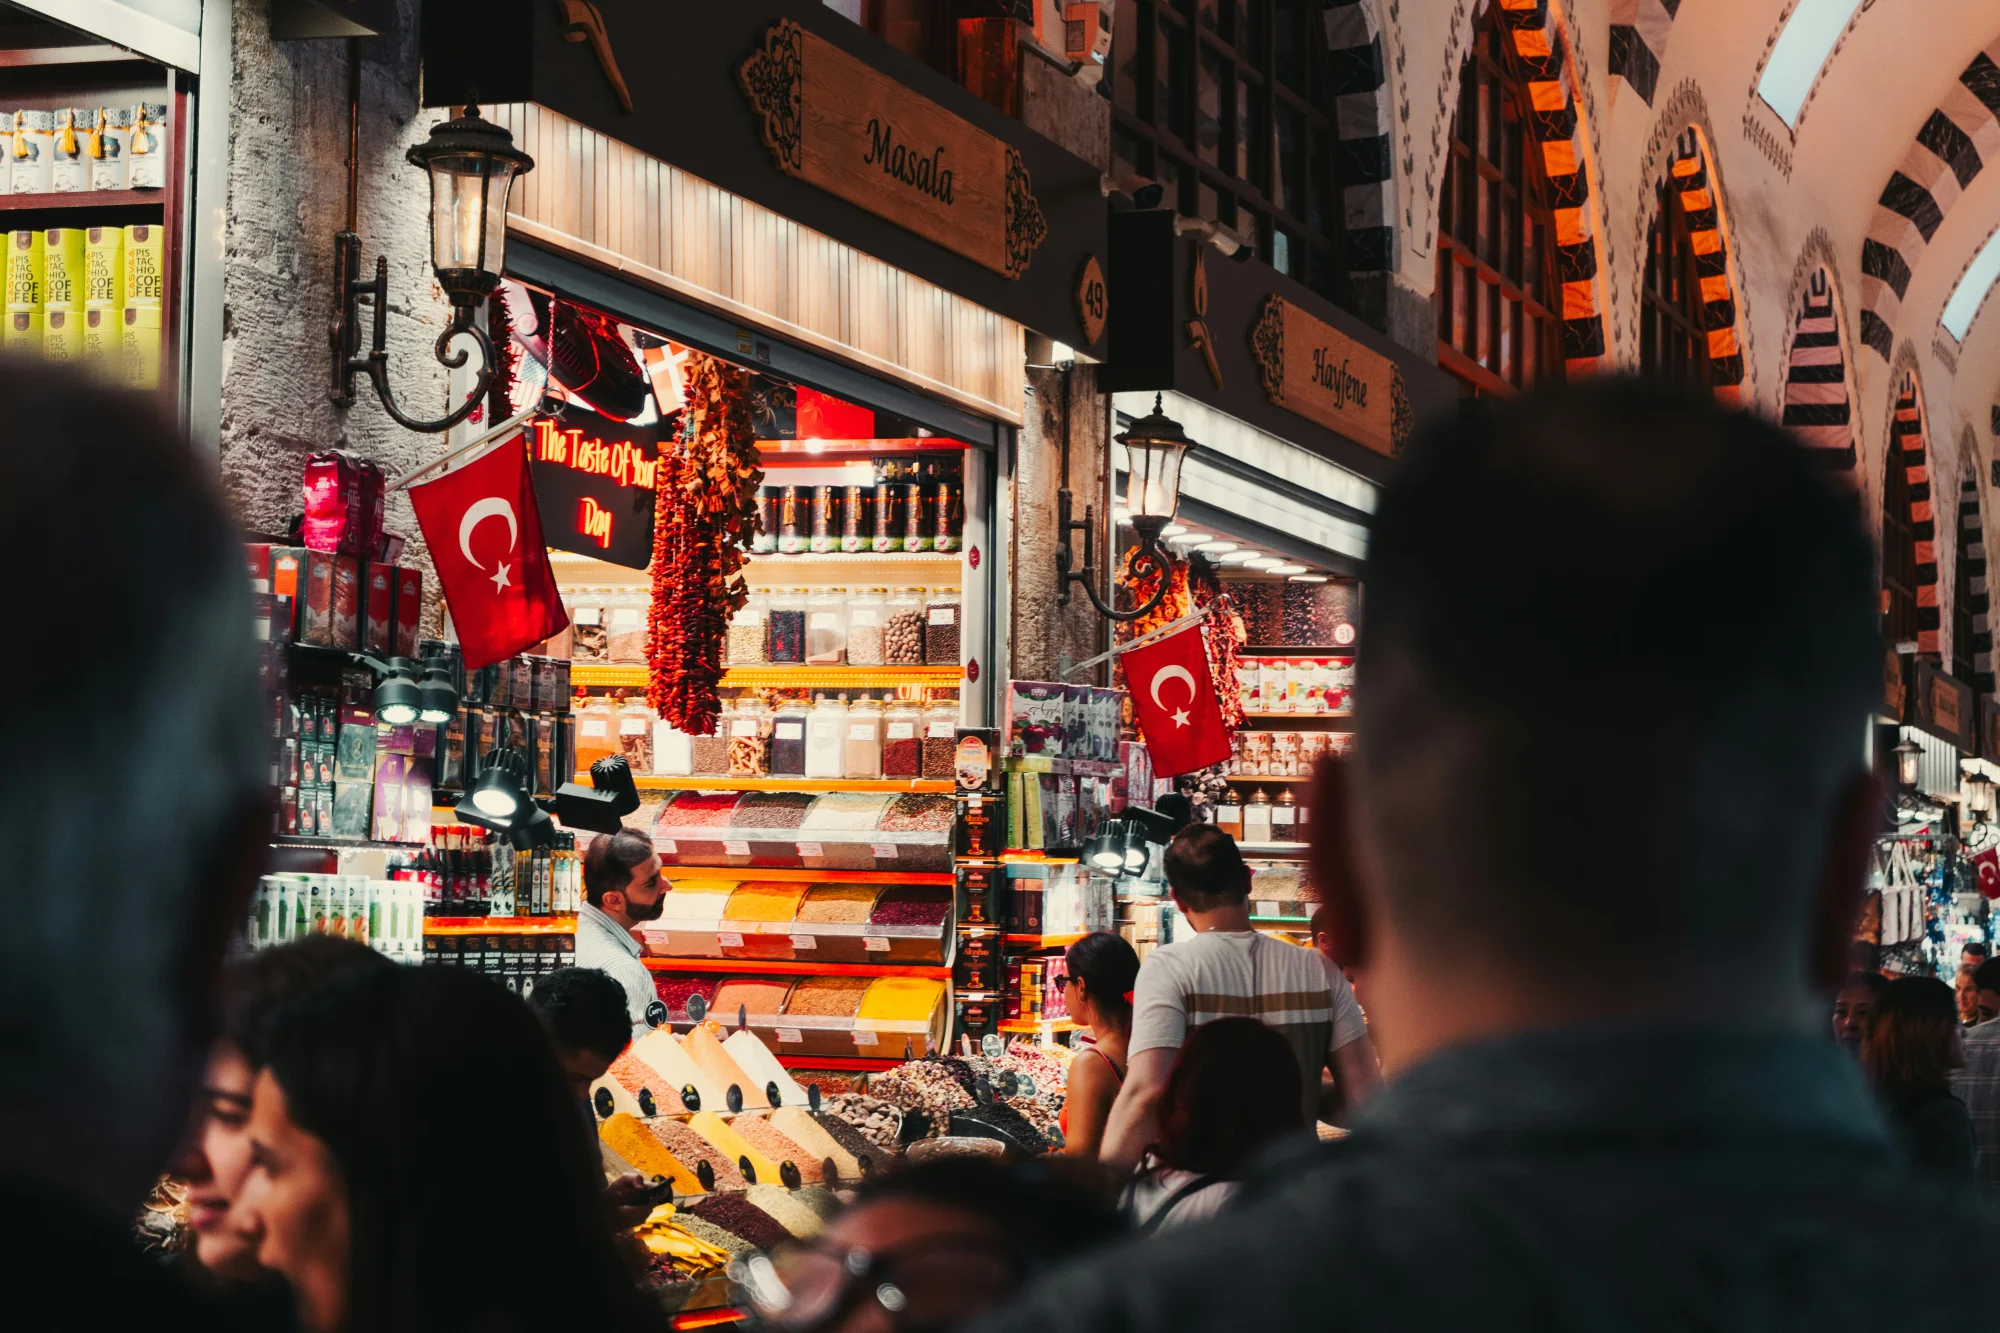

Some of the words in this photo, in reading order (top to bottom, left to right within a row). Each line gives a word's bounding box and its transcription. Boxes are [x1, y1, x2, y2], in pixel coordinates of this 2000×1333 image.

[864, 118, 955, 206] Masala
[49, 254, 61, 262] PIS
[136, 249, 150, 257] PIS
[49, 262, 64, 270] TAC
[91, 260, 107, 268] TAC
[136, 257, 154, 265] TAC
[15, 264, 32, 272] TAC
[91, 268, 108, 276] HIO
[136, 266, 155, 274] HIO
[49, 271, 66, 279] HIO
[49, 280, 71, 291] COF
[91, 278, 113, 288] COF
[136, 275, 161, 286] COF
[15, 282, 38, 292] COF
[136, 286, 161, 297] FEE
[15, 293, 38, 303] FEE
[48, 291, 71, 302] FEE
[91, 289, 113, 299] FEE
[1086, 280, 1103, 319] 49
[50, 334, 63, 342] PIS
[1311, 347, 1367, 410] Hayfene
[534, 419, 567, 463] The
[565, 429, 610, 473] Taste
[611, 441, 631, 487] Of
[631, 448, 658, 489] Your
[580, 497, 613, 549] Day
